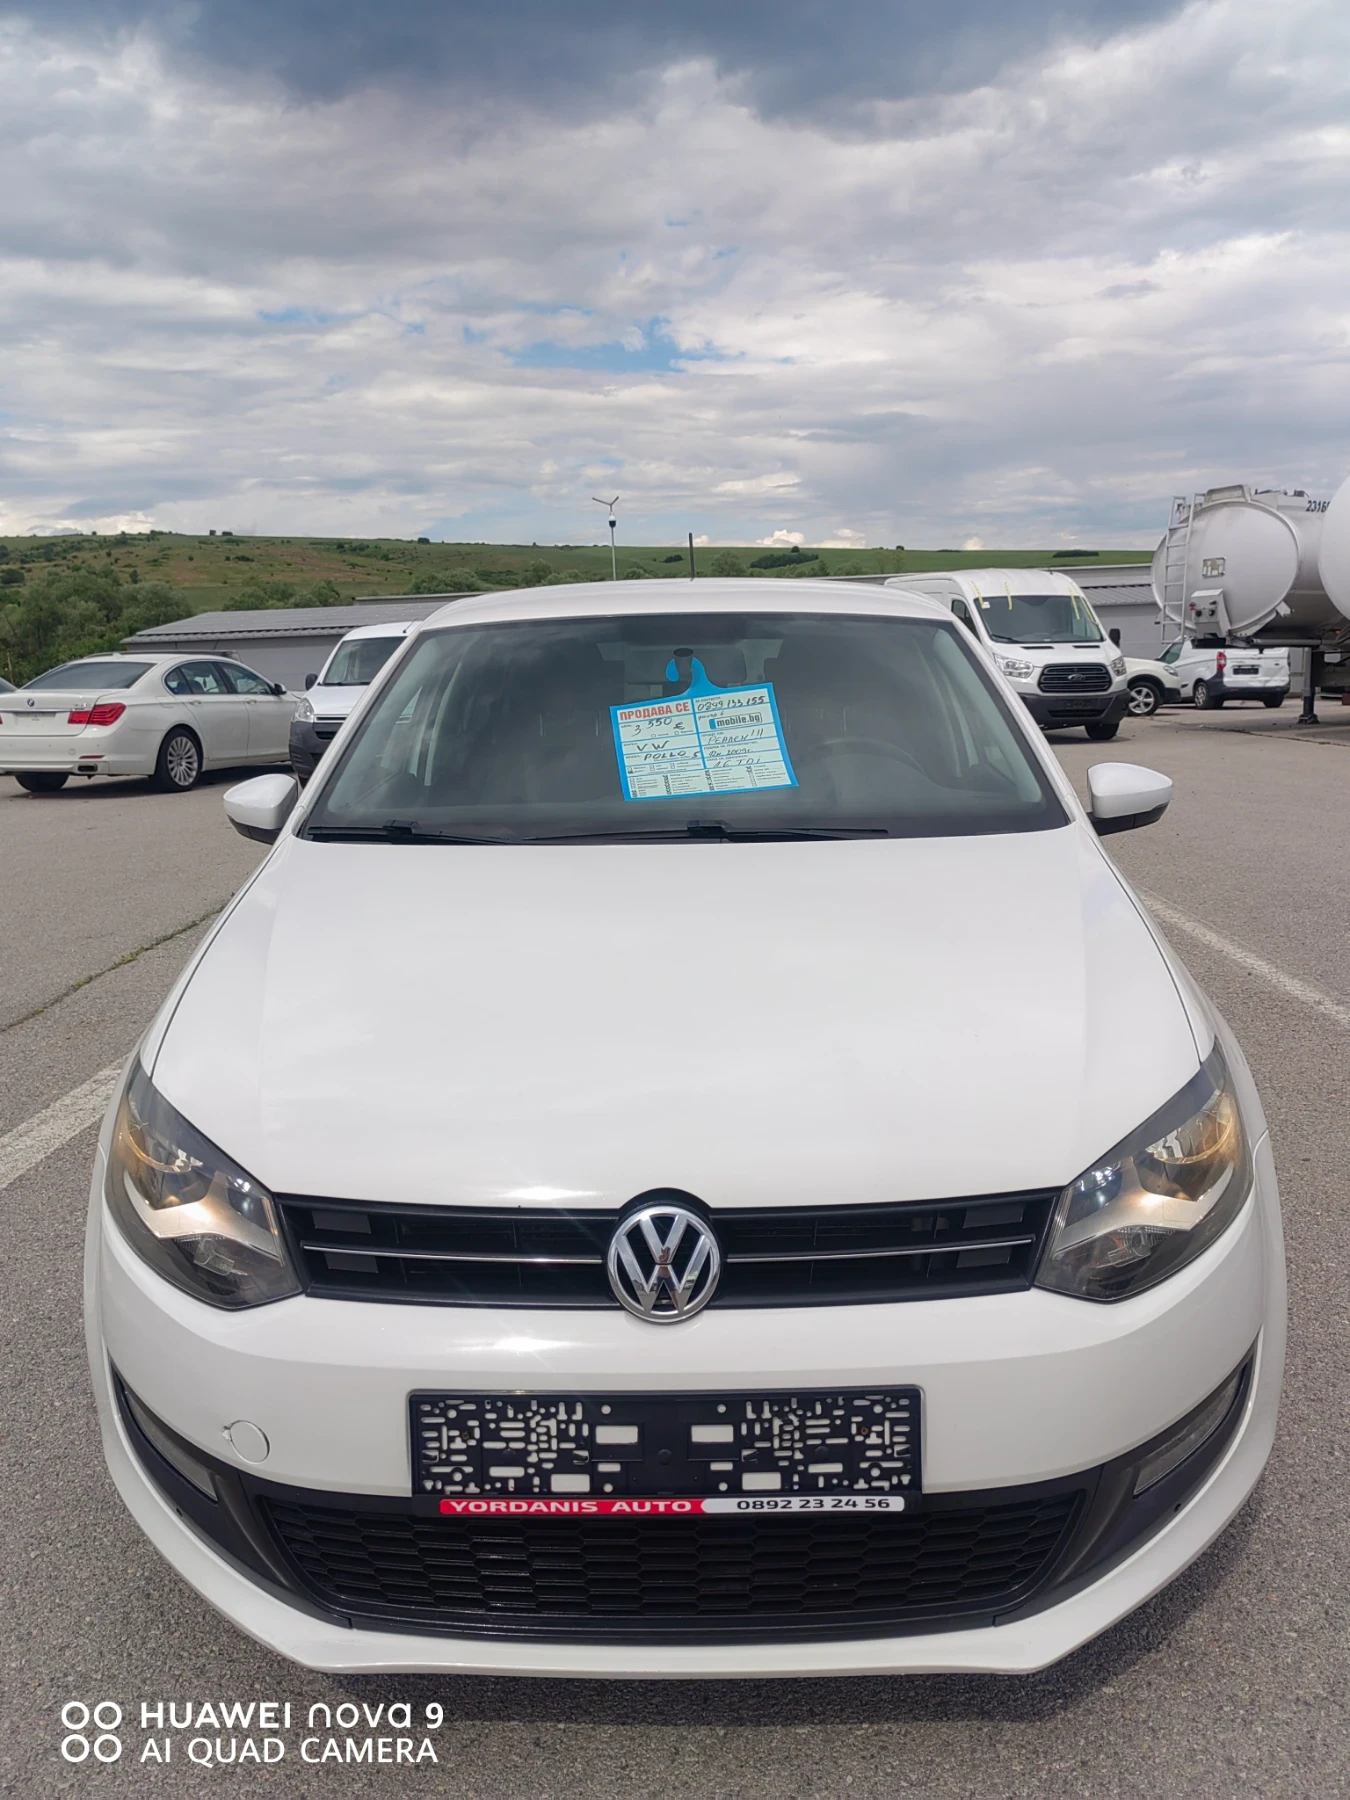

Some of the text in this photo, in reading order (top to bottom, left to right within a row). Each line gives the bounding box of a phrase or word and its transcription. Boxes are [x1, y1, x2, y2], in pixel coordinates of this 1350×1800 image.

[620, 702, 690, 721] ПРОДАВА СЕ
[716, 714, 760, 727] mobile.bg
[449, 1500, 692, 1513] YORDANIS AUTO
[736, 1498, 891, 1511] 0892 23 24 56
